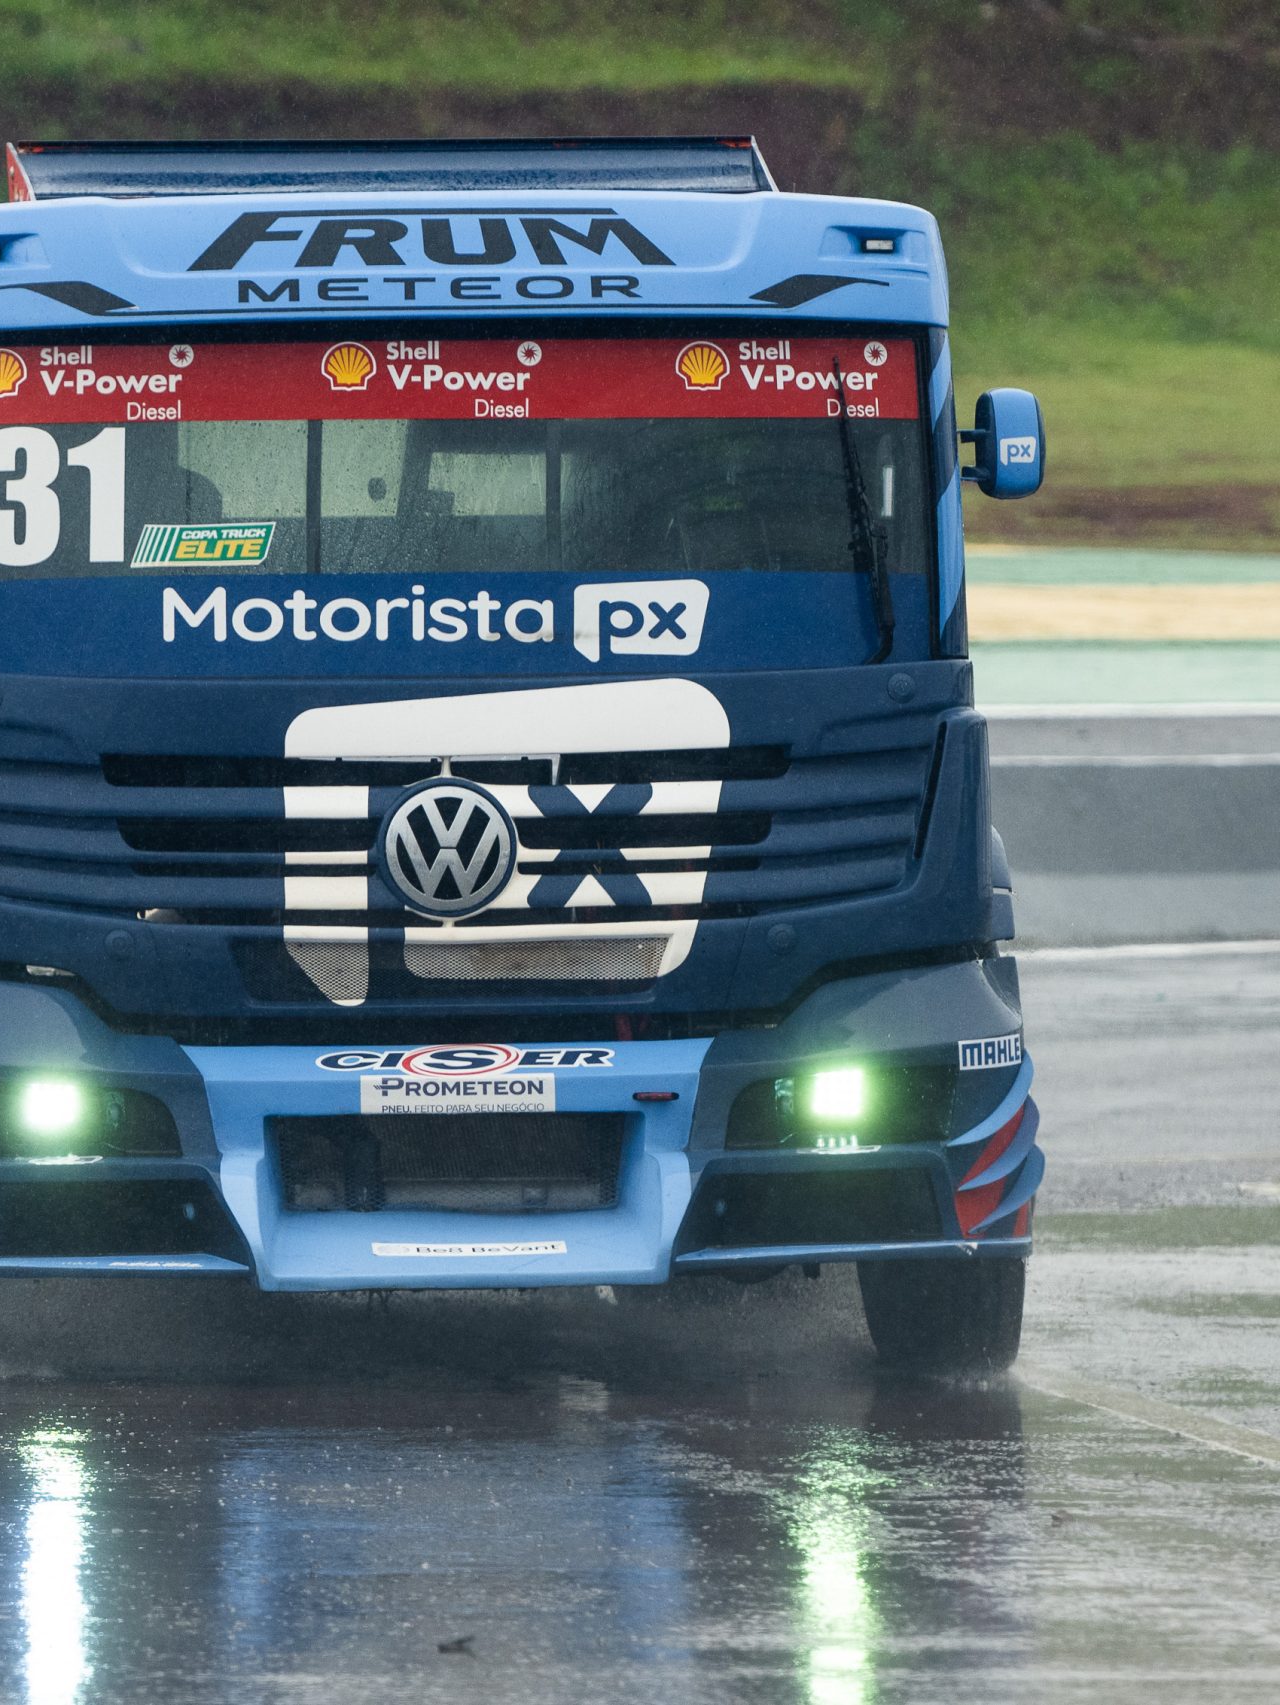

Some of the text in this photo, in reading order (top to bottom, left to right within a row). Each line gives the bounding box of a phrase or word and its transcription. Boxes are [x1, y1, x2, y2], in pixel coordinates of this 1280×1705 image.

[186, 207, 677, 272] FRUM
[238, 275, 643, 303] METEOR
[40, 345, 92, 366] Shell
[386, 340, 440, 360] Shell
[738, 340, 791, 360] Shell
[40, 369, 183, 396] V-Power
[386, 364, 531, 391] V-Power
[126, 400, 182, 420] Diesel
[474, 398, 529, 418] Diesel
[826, 397, 880, 417] Desel
[181, 528, 267, 540] COPA TRUCK
[175, 539, 264, 559] ELITE
[163, 585, 554, 642] Motorista
[319, 1046, 612, 1074] CISER
[962, 1037, 1020, 1067] MAHLE
[379, 1077, 544, 1097] PROMETEON
[414, 1103, 444, 1114] FEITO
[446, 1103, 472, 1113] PARA
[474, 1103, 495, 1113] SEU
